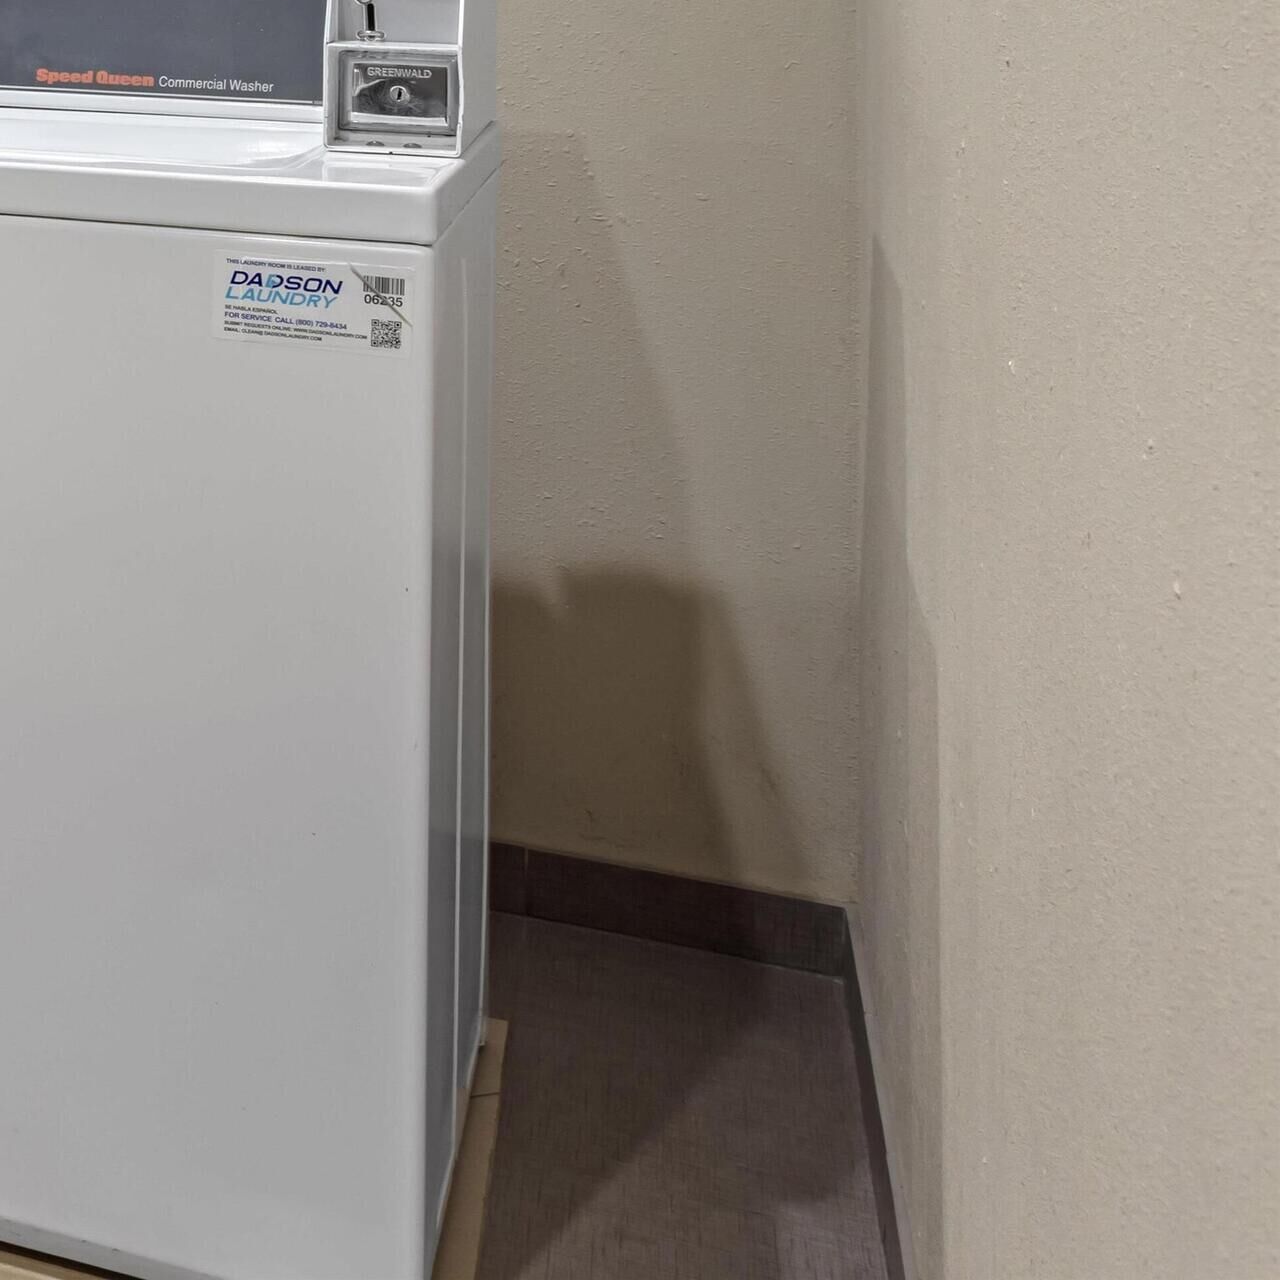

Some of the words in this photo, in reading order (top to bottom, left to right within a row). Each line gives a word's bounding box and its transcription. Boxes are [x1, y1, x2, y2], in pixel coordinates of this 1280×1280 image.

[36, 68, 93, 85] Speed
[95, 70, 154, 87] Queen
[159, 75, 227, 90] Commercial
[229, 79, 275, 93] Washer
[367, 67, 432, 78] GREENWALD
[230, 270, 343, 294] DADSON
[225, 286, 338, 309] LAUNDRY
[225, 311, 240, 319] FOR
[241, 312, 272, 322] SERVICE
[275, 316, 294, 325] CALL
[295, 317, 314, 328] (800)
